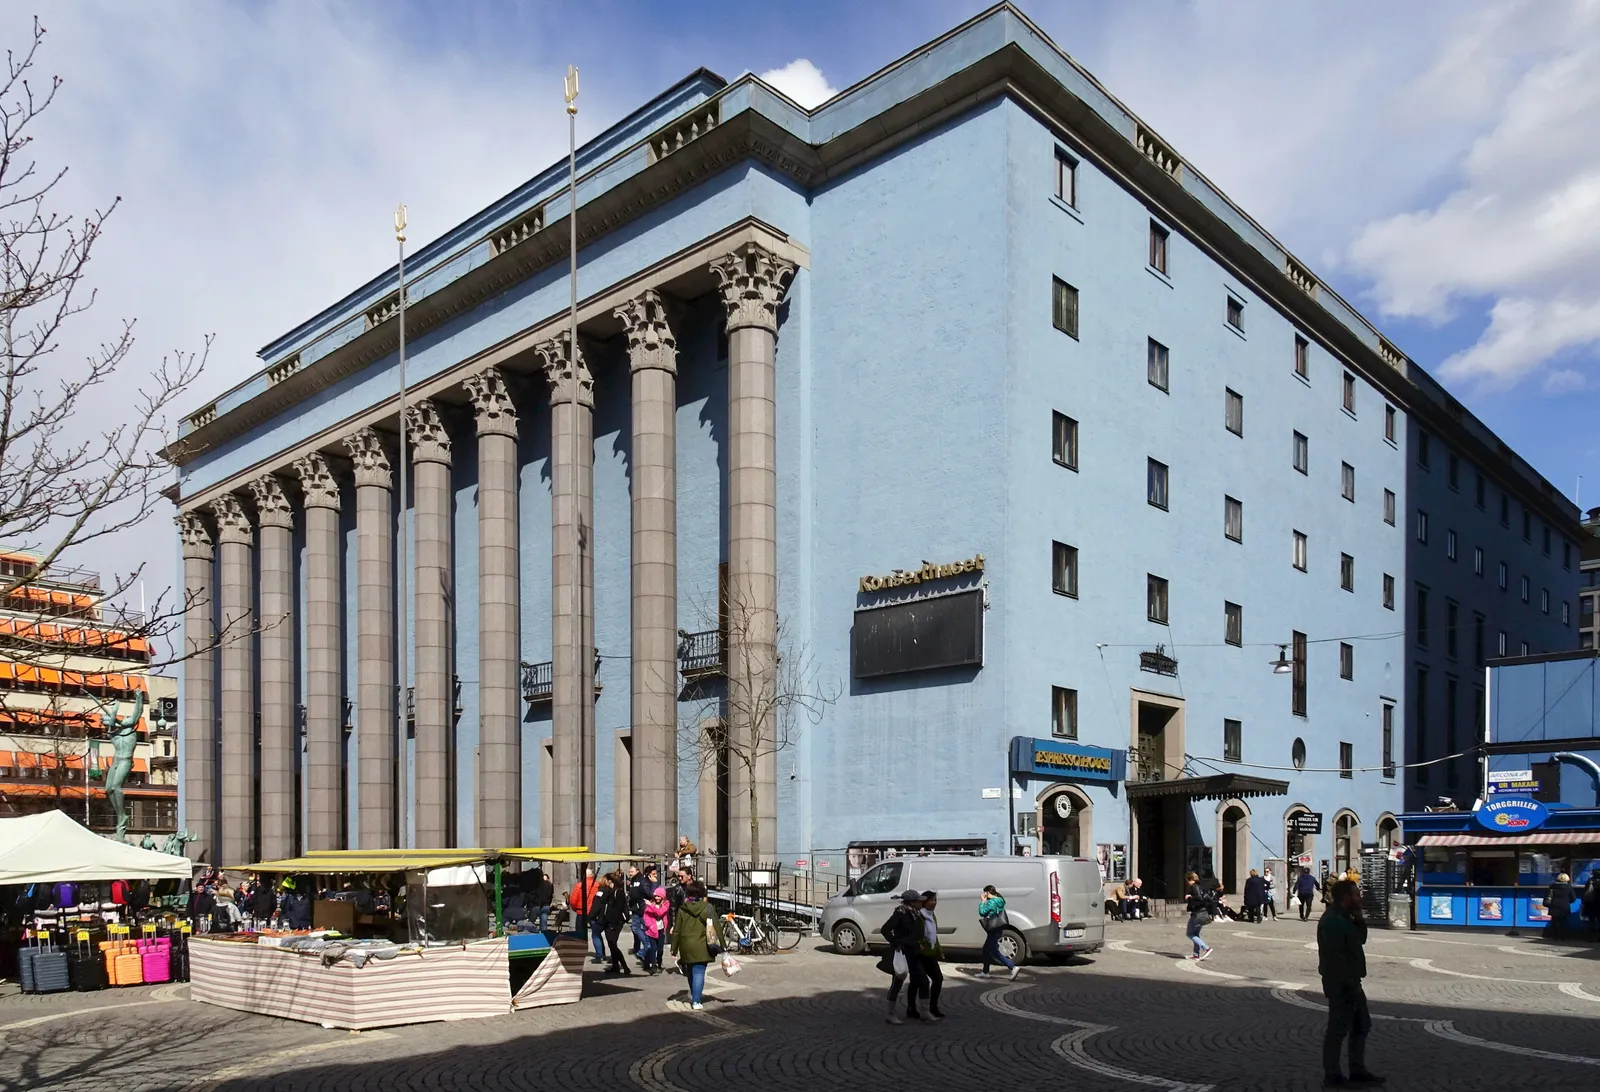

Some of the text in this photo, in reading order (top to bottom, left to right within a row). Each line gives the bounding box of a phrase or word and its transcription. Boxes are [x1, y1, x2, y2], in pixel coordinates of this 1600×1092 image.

[860, 554, 984, 592] Konserthuset
[1036, 750, 1111, 770] ESPRESSO HOUSE
[1485, 800, 1539, 812] TORGGRILLEN
